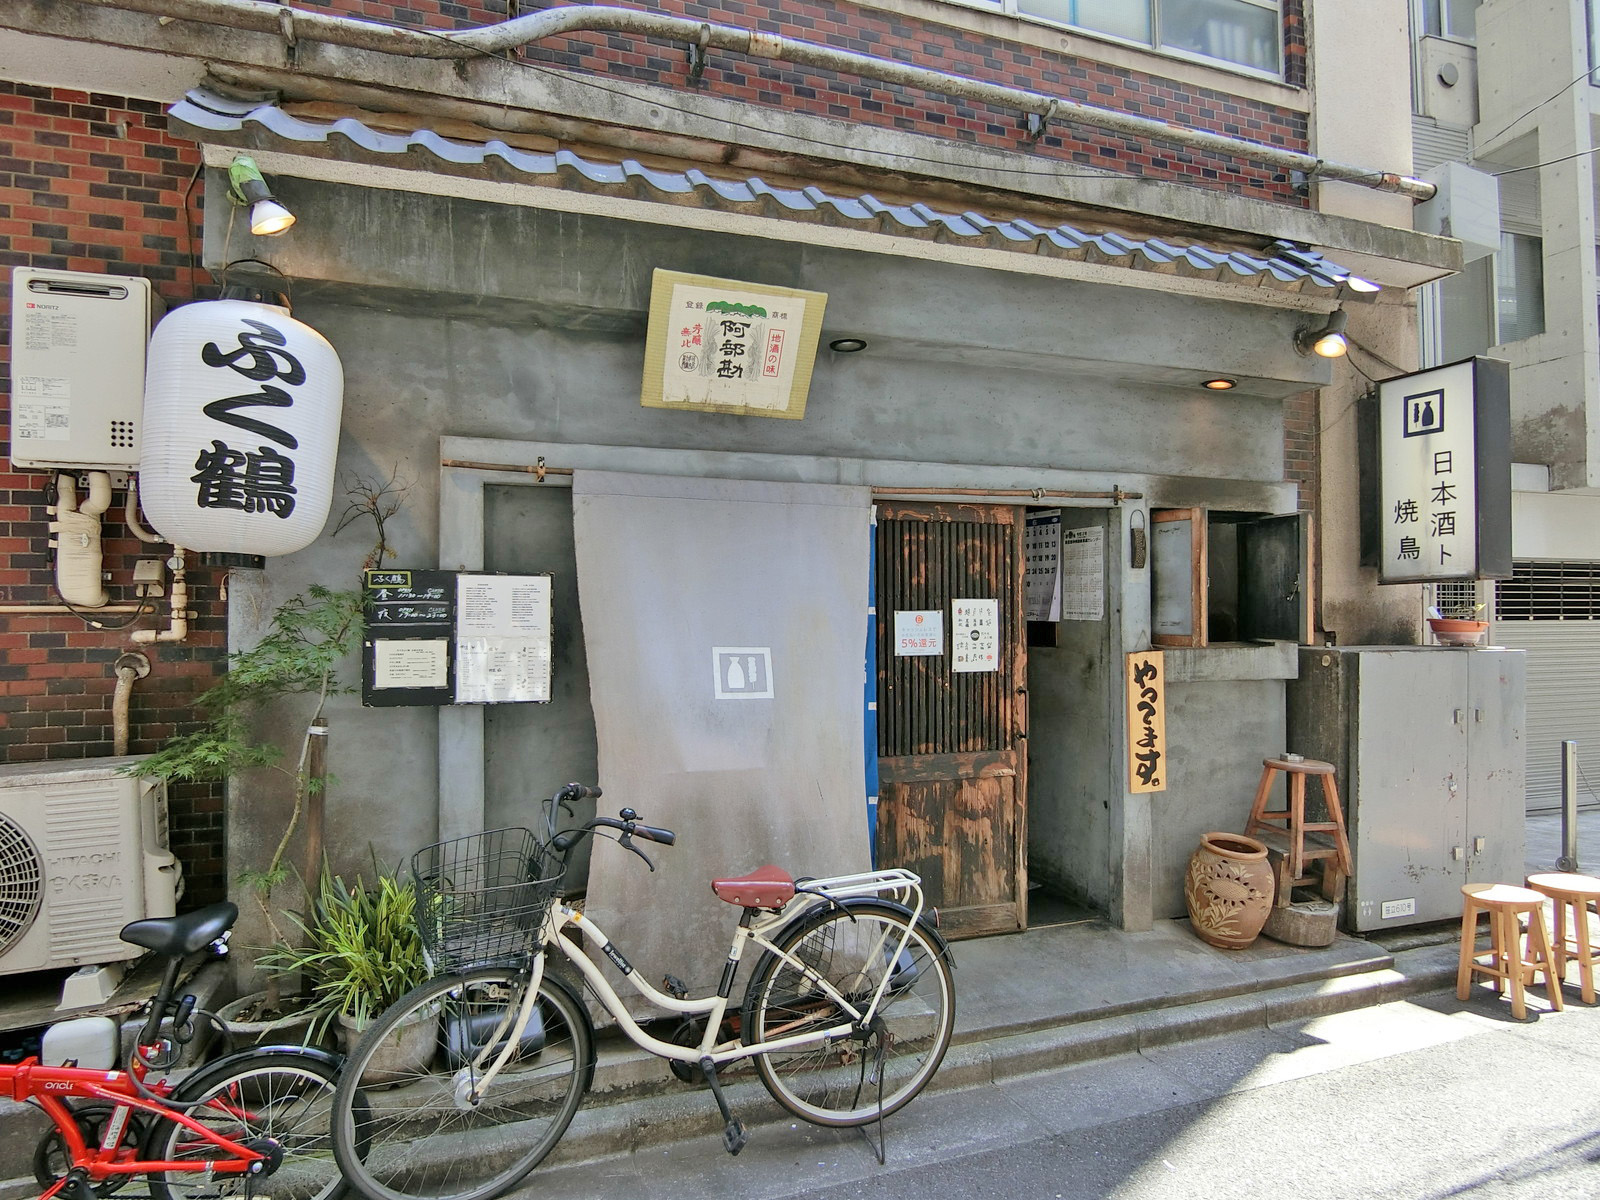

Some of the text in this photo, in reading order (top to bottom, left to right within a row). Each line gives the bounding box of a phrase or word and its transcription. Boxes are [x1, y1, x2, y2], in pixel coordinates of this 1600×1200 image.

[716, 320, 751, 379] 阿部勘
[765, 334, 781, 375] 地酒の味
[190, 318, 307, 520] ふく鶴
[1430, 450, 1457, 566] 日本酒ト
[1394, 498, 1421, 561] 焼鳥
[373, 574, 406, 584] ふく鶴
[375, 588, 393, 600] 昼
[901, 638, 937, 648] 5%還元
[48, 851, 121, 867] HITACHI
